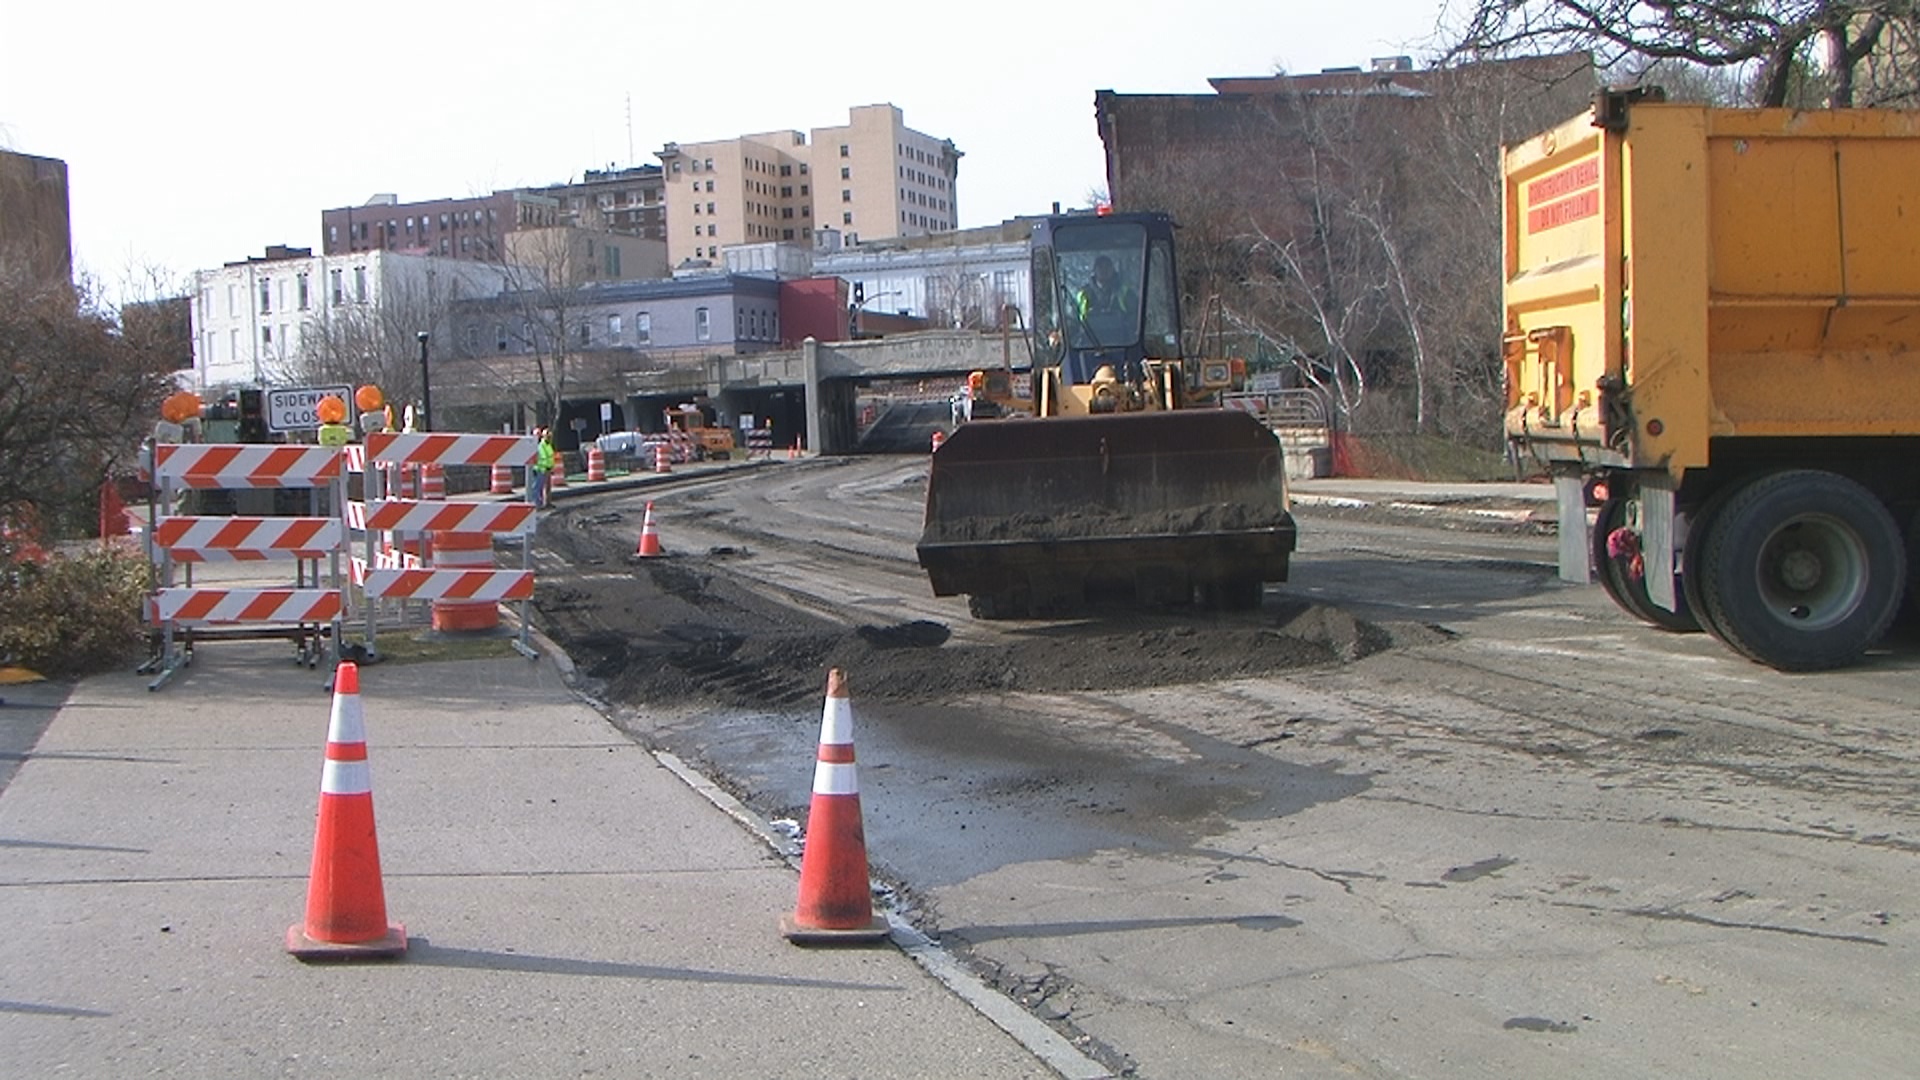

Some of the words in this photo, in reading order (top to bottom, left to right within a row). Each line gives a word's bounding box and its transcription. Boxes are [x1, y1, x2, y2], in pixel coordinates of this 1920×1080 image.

[1564, 192, 1590, 219] FOLLOW
[275, 391, 345, 408] SIDEWAK
[283, 409, 320, 425] CLOS
